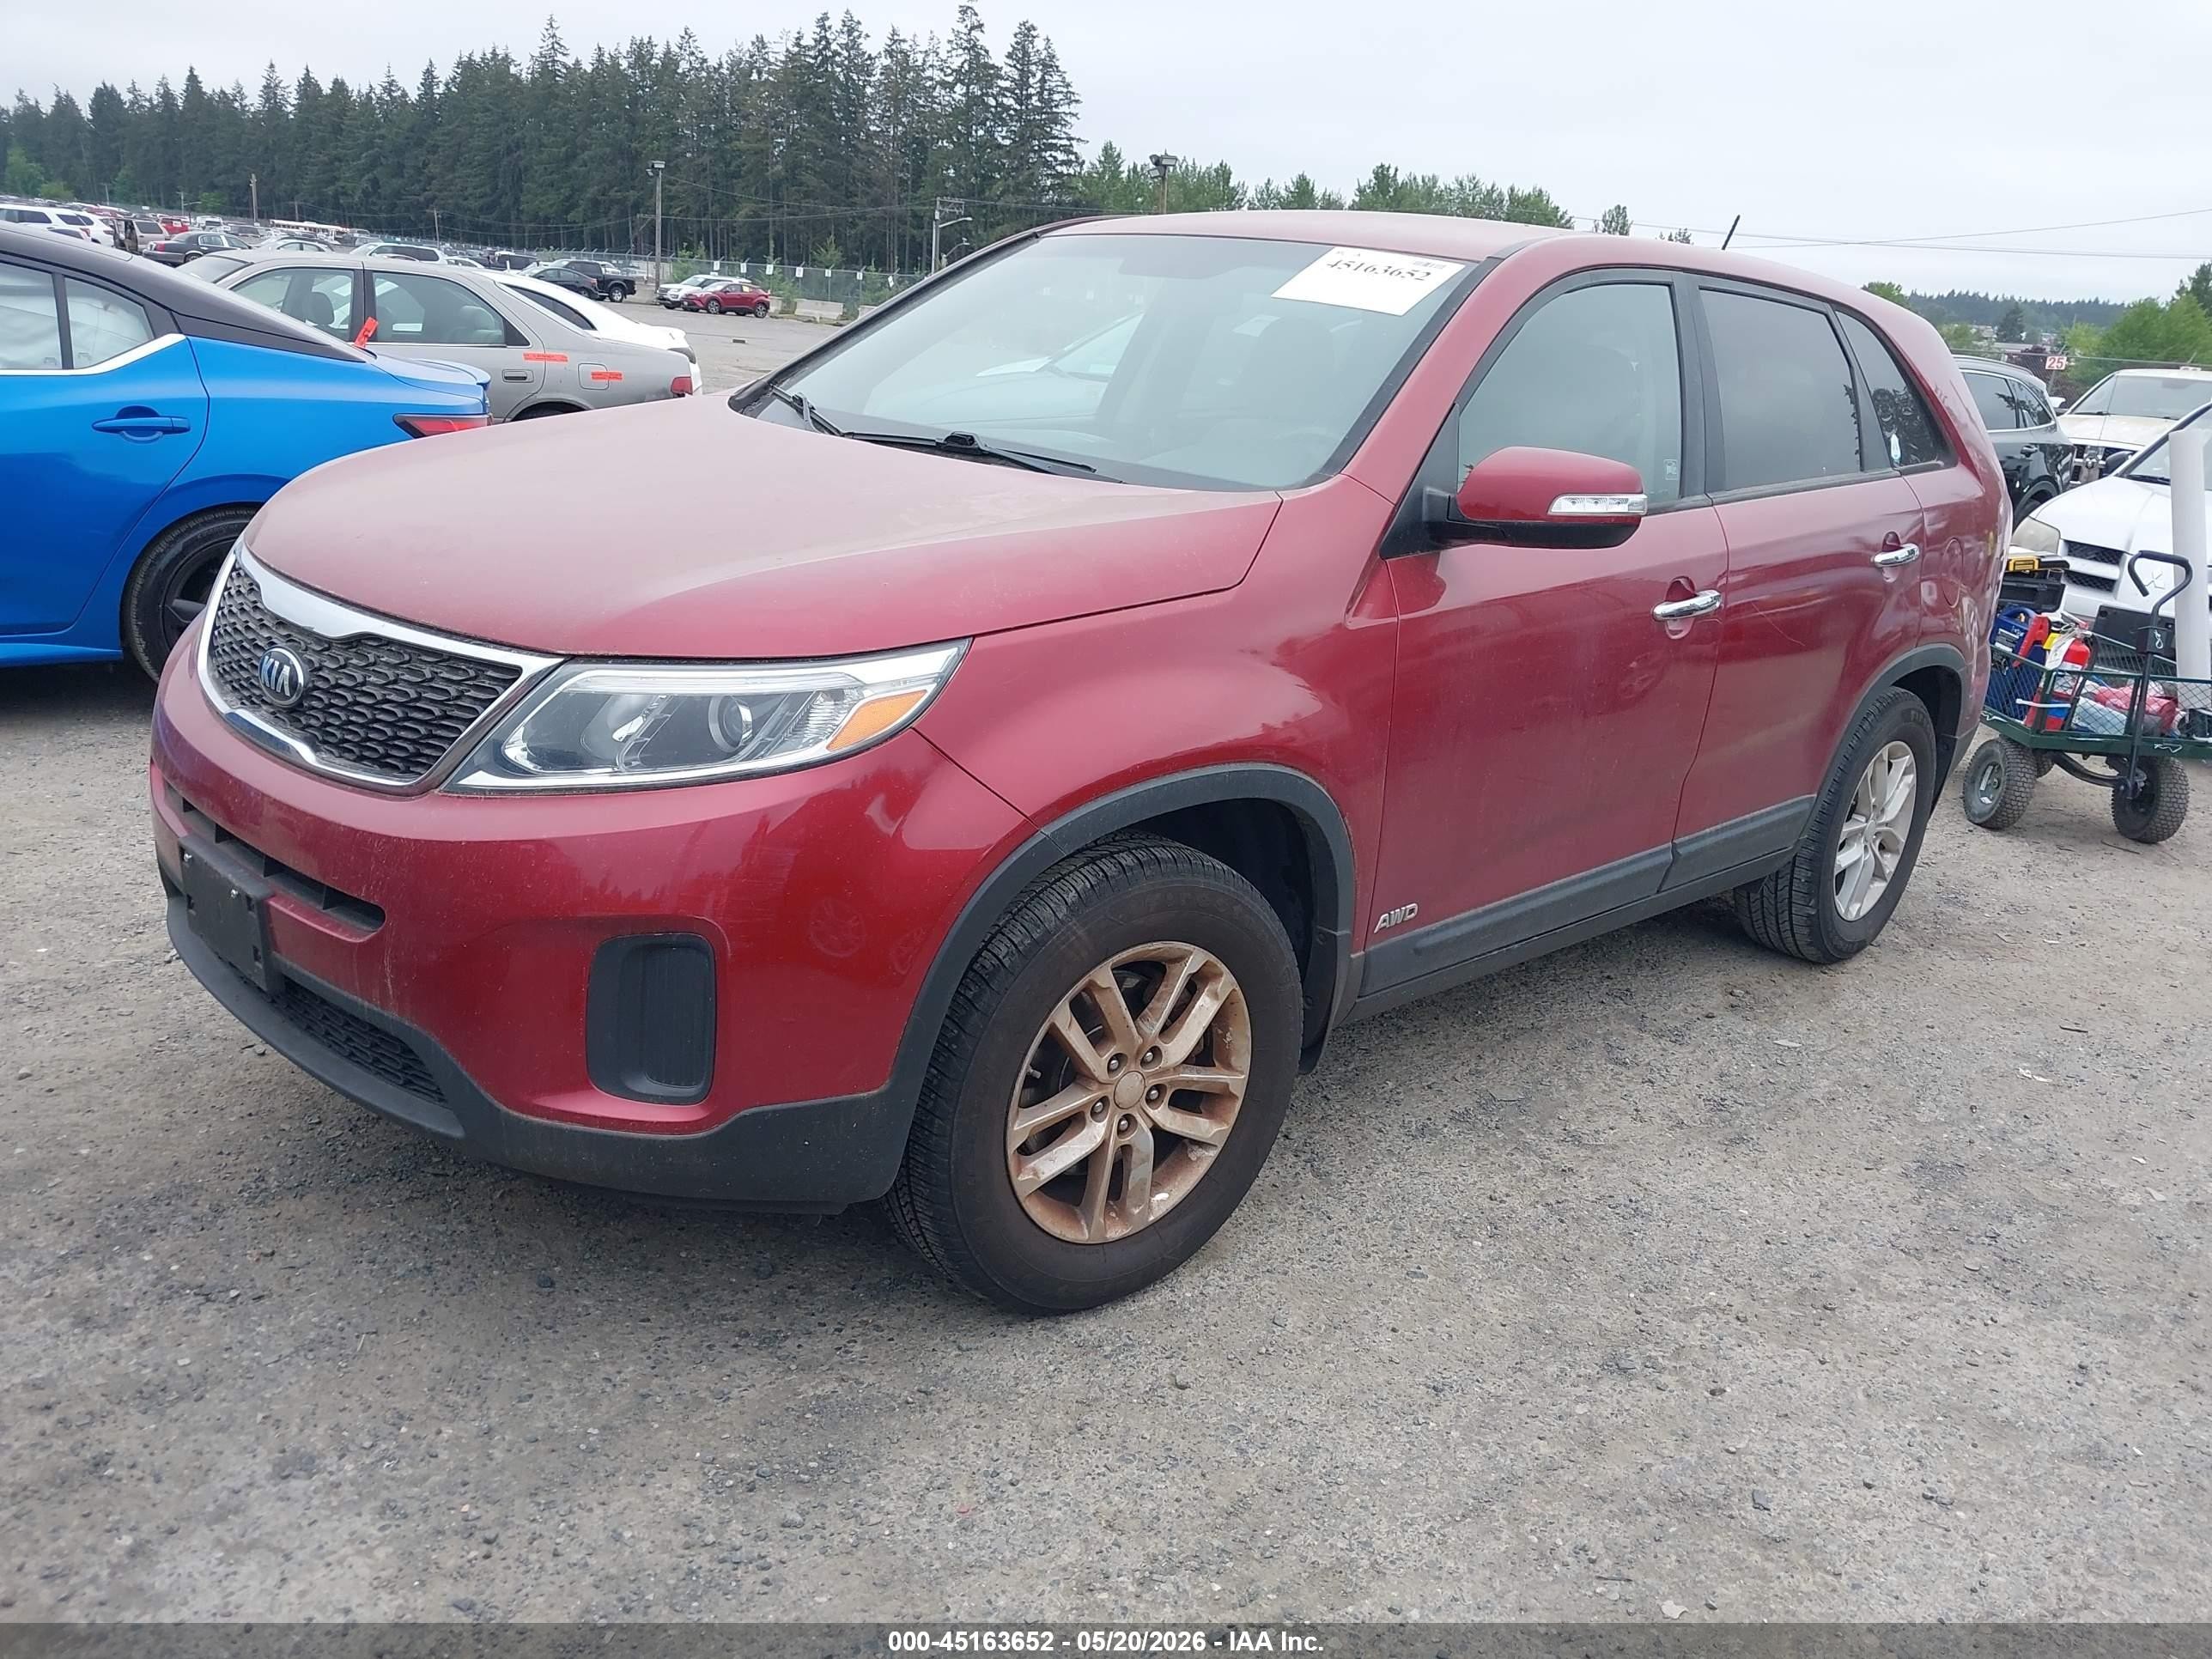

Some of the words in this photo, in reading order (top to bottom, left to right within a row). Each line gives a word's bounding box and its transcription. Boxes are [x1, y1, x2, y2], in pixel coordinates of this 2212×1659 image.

[1327, 259, 1431, 281] 45163652
[2047, 356, 2064, 369] 25
[261, 655, 291, 696] KIA
[1374, 902, 1419, 934] AWD
